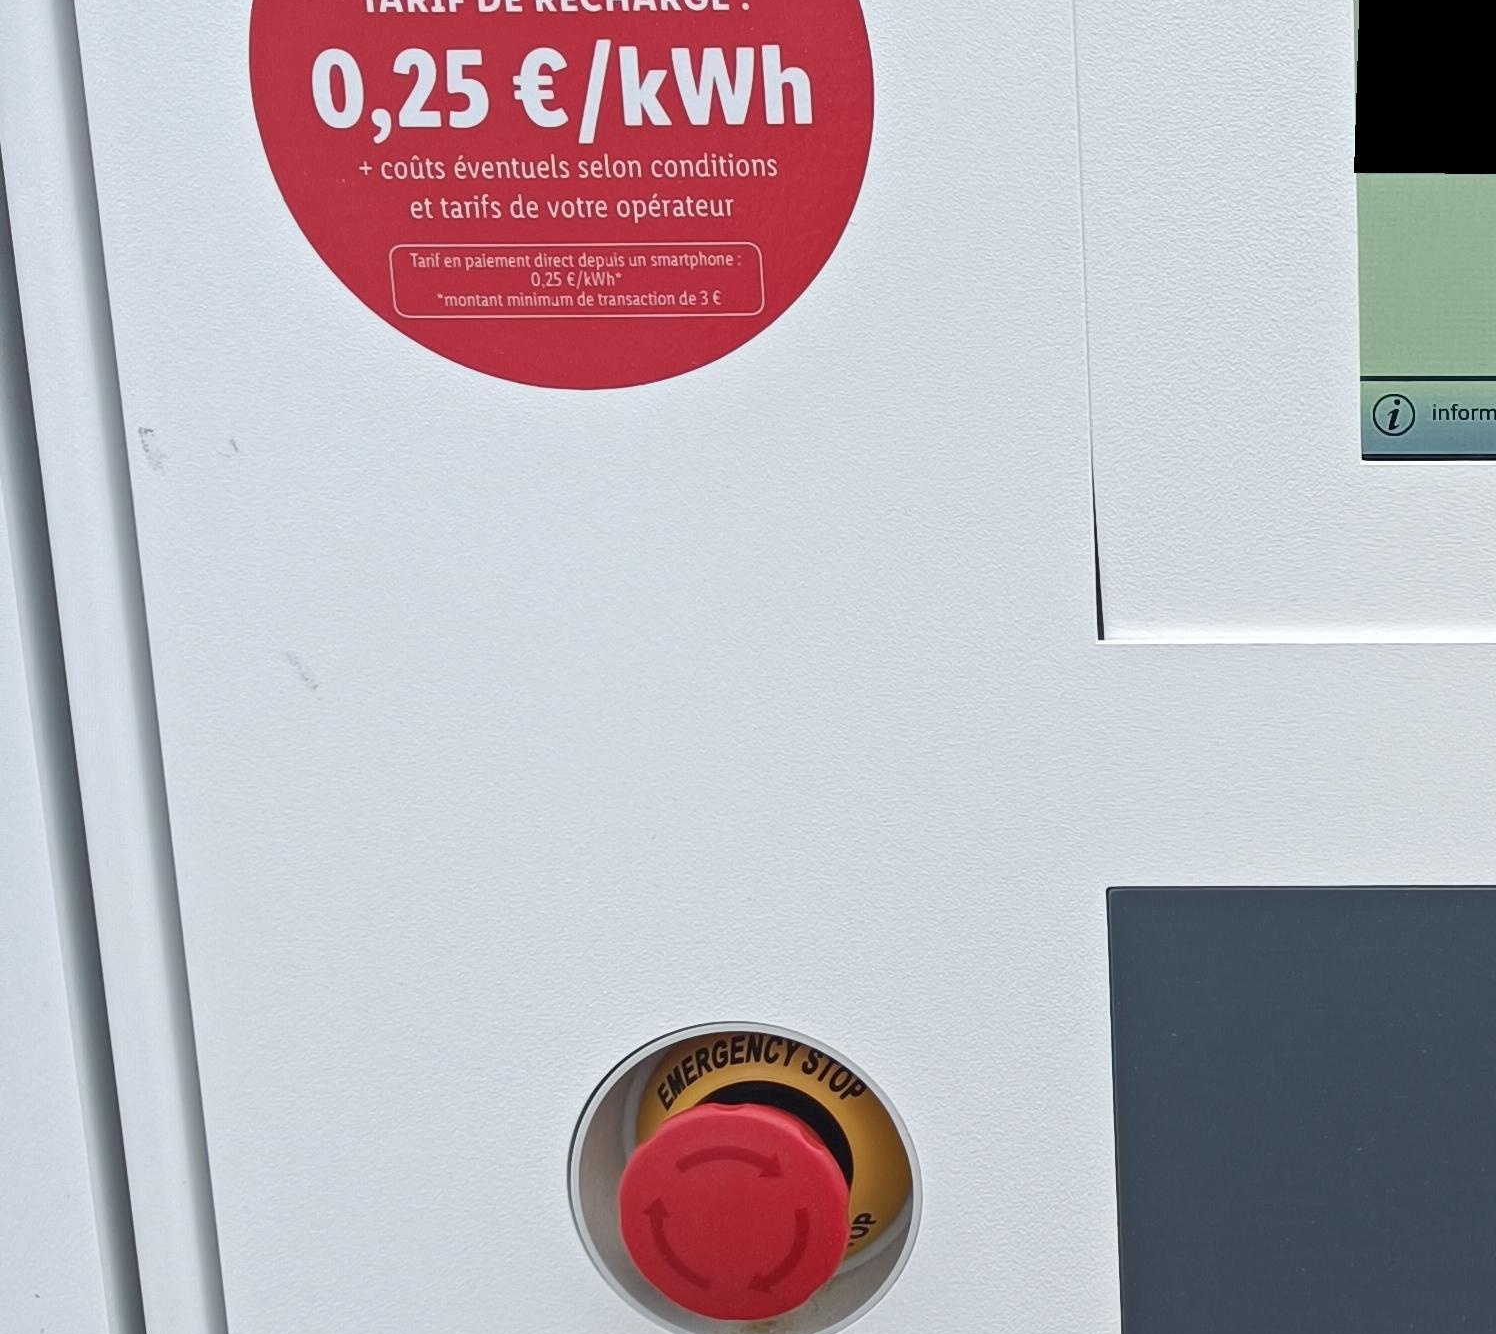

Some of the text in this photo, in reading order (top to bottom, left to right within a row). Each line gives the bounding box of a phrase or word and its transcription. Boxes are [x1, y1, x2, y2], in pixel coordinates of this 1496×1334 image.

[311, 47, 490, 144] 0,25
[380, 154, 446, 180] coûts
[453, 153, 570, 180] éventuels
[577, 153, 642, 179] selon
[650, 152, 778, 178] conditions
[410, 192, 734, 224] et tarifs de votre opérateur
[657, 1033, 868, 1111] EMERGENCY STOP
